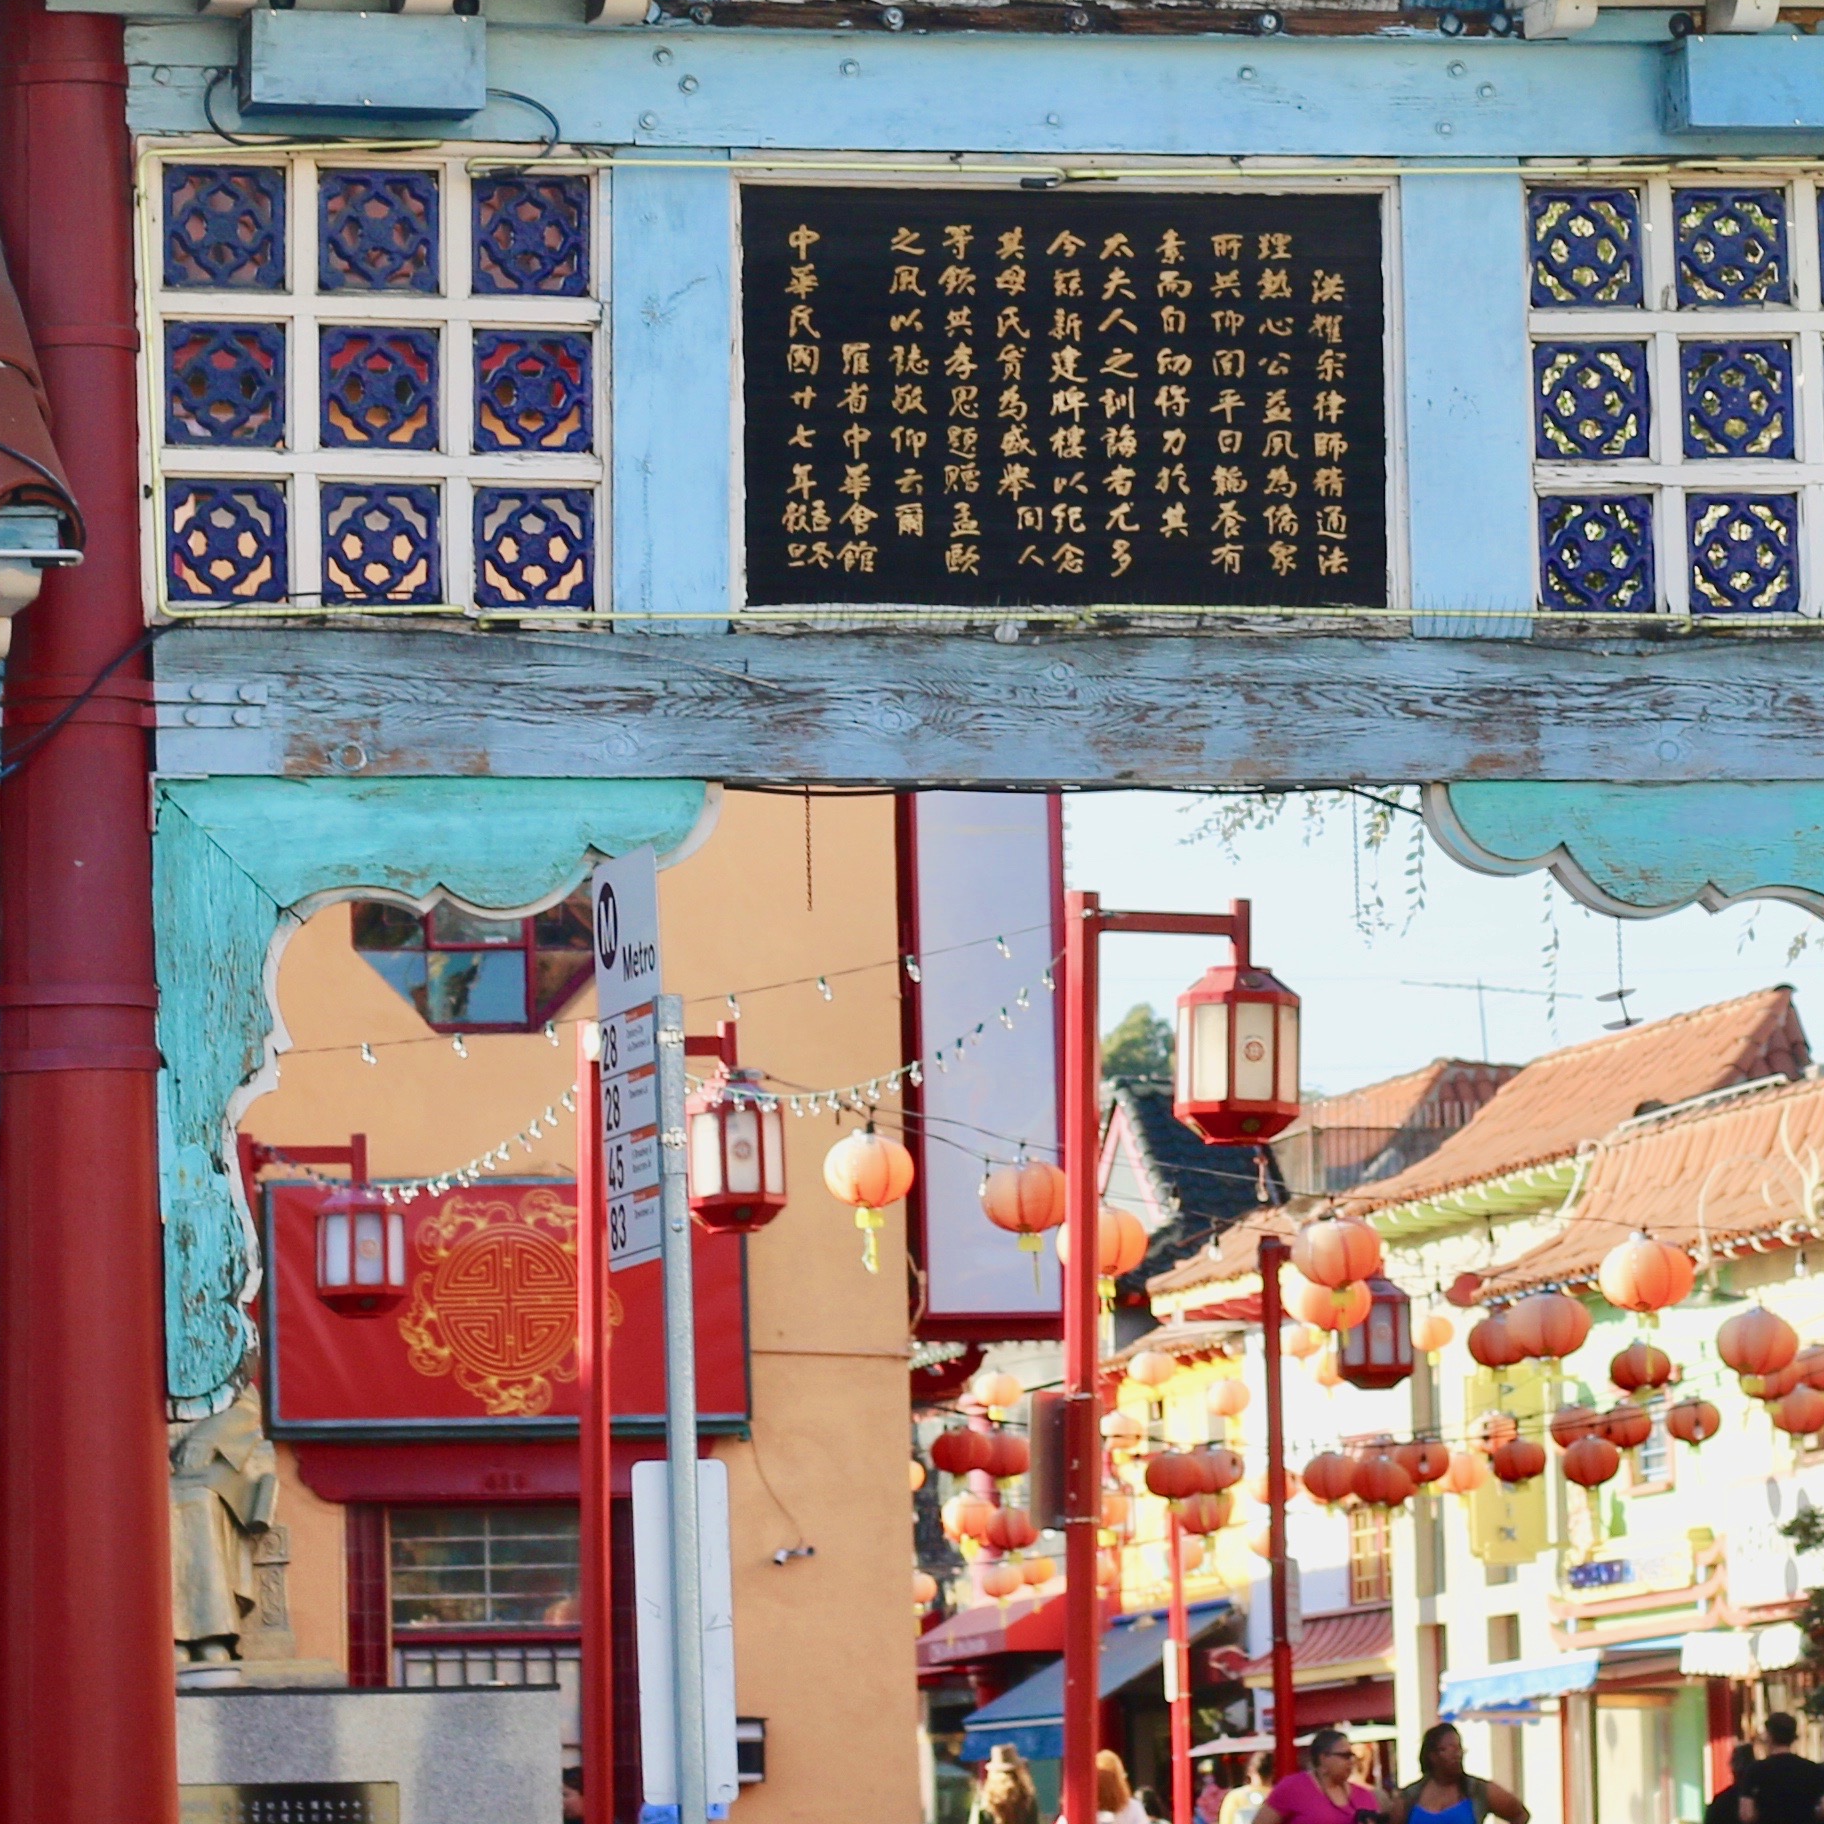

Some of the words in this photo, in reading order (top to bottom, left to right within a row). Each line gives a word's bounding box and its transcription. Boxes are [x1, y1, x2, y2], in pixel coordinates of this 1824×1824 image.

[622, 940, 656, 983] Metro
[601, 1024, 619, 1072] 28
[604, 1084, 621, 1132] 28
[608, 1144, 625, 1191] 45
[610, 1203, 627, 1252] 83
